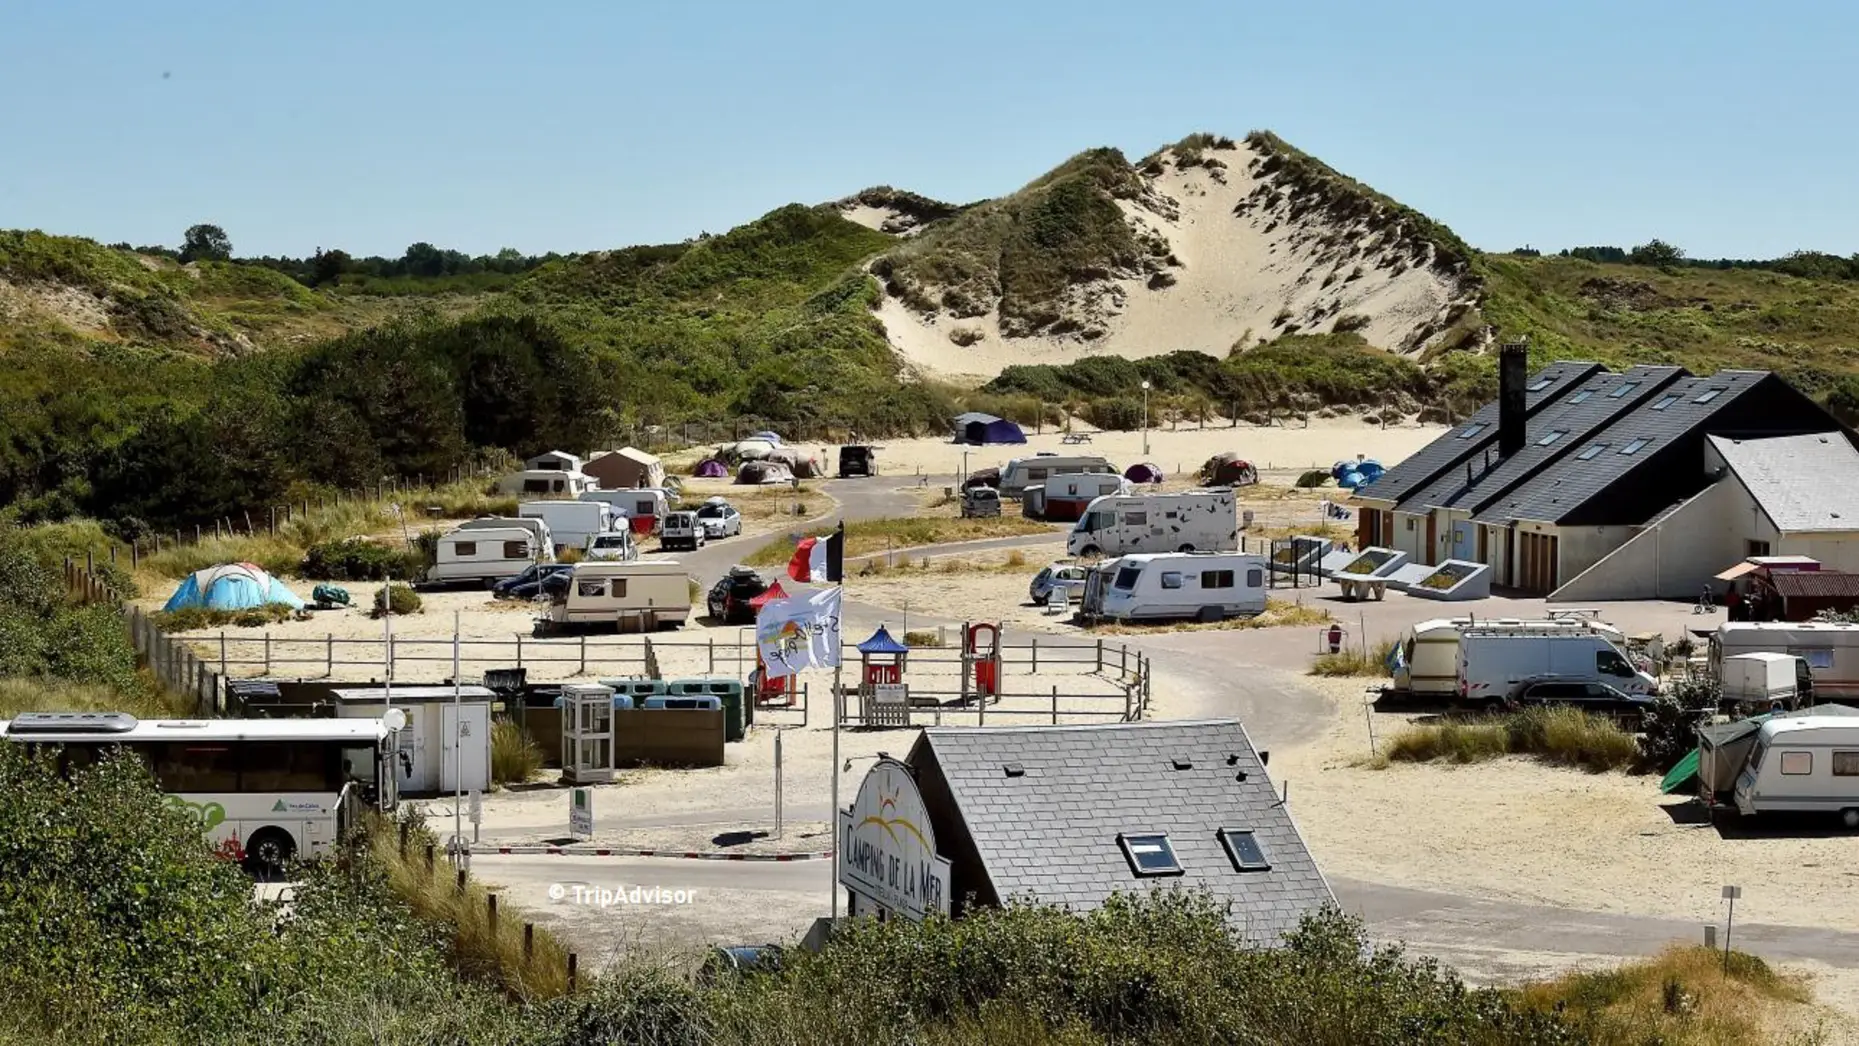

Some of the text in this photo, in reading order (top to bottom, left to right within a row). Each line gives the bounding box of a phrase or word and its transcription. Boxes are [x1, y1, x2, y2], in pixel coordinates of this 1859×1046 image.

[888, 853, 901, 891] DE
[903, 861, 916, 899] LA
[919, 859, 942, 912] MER
